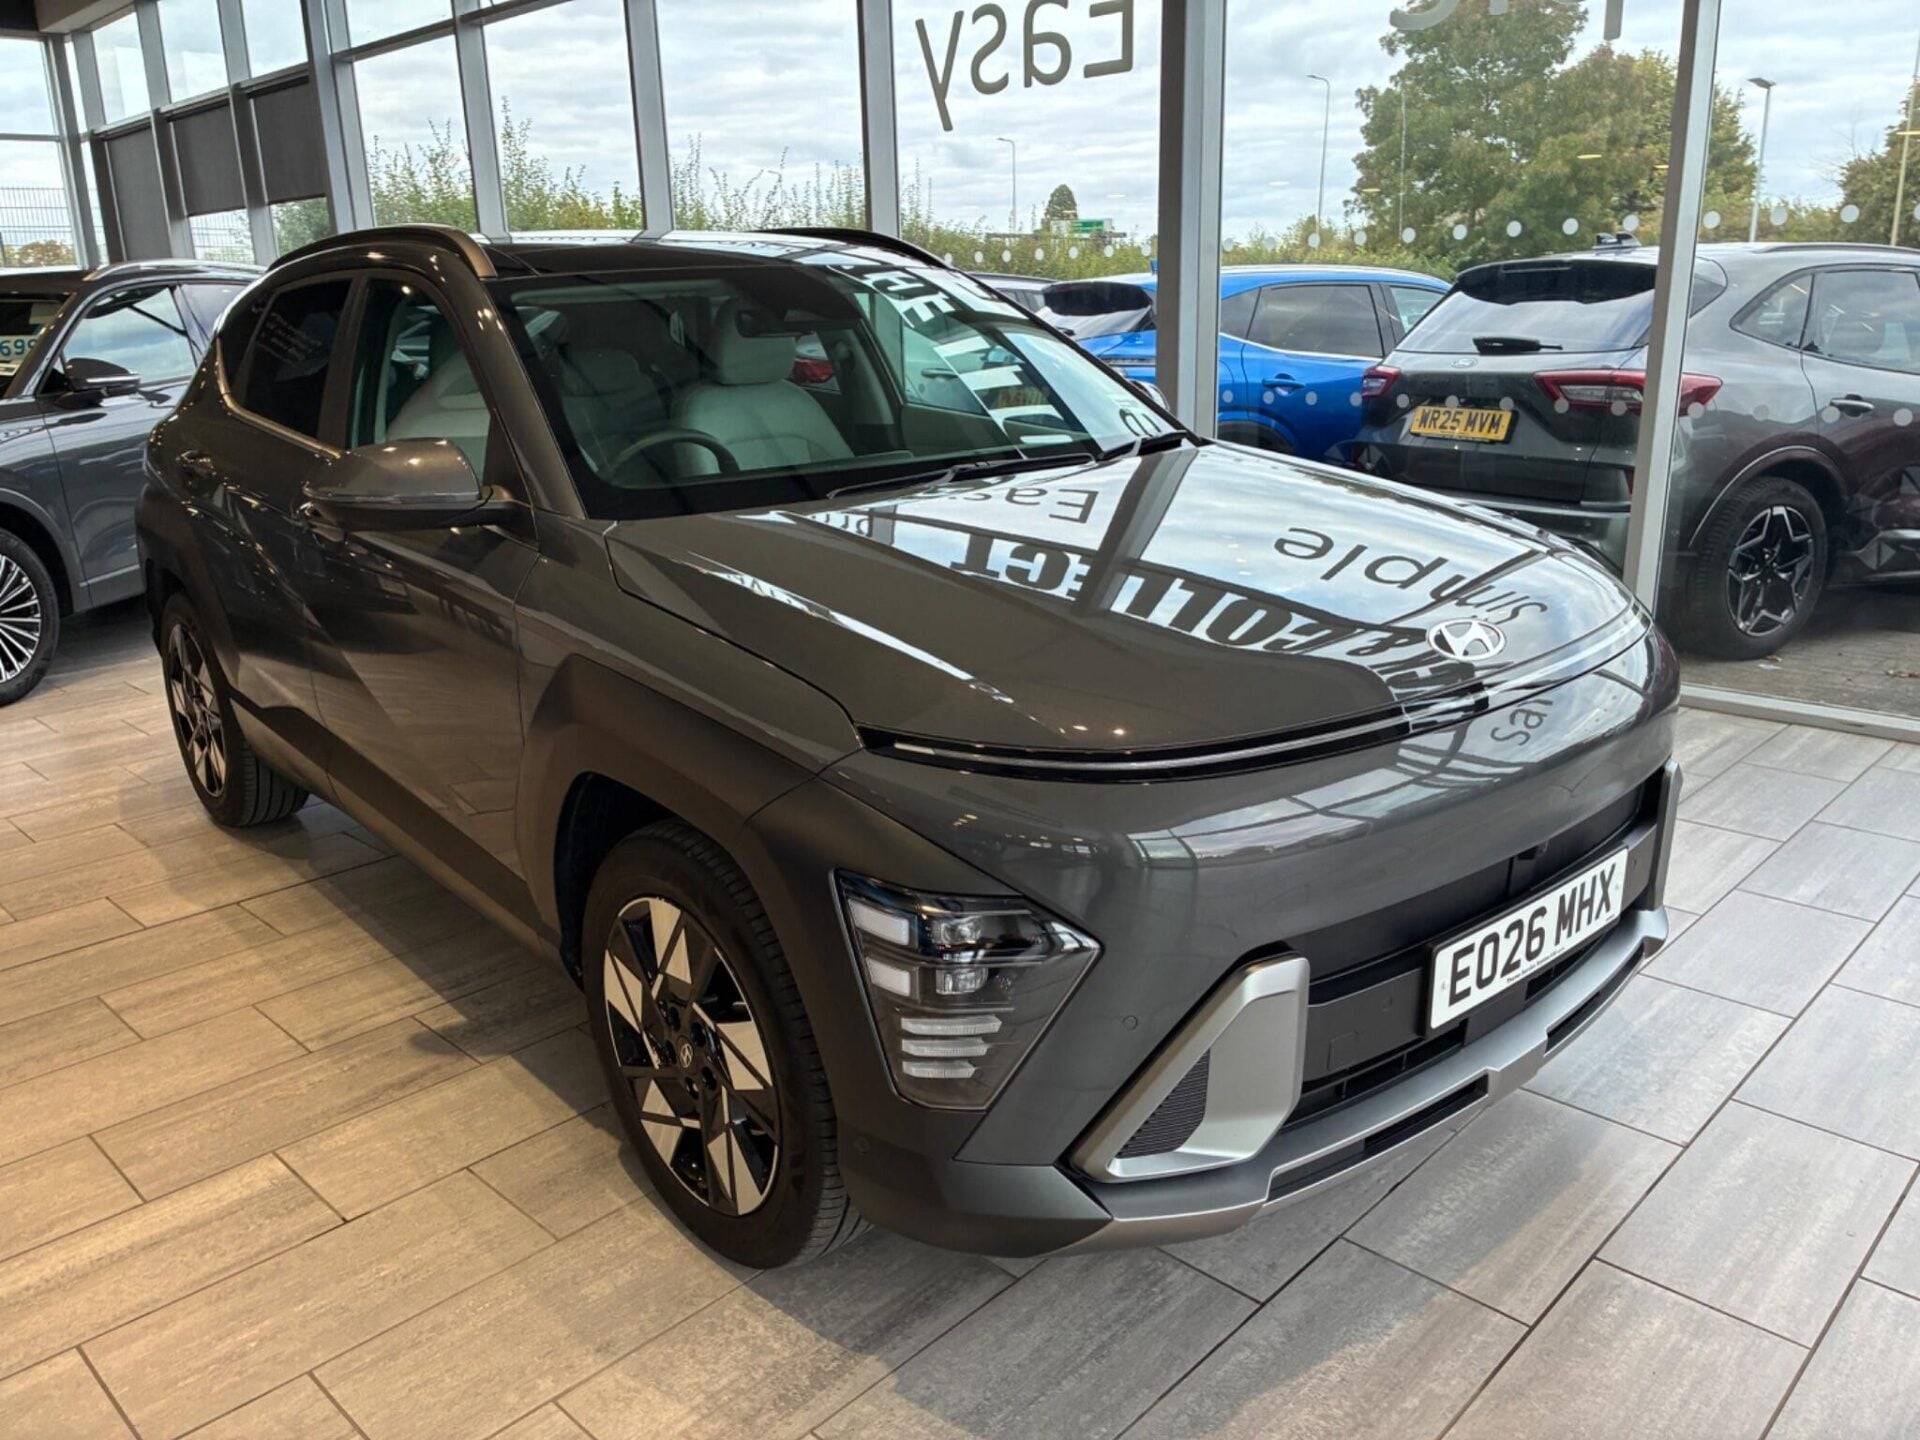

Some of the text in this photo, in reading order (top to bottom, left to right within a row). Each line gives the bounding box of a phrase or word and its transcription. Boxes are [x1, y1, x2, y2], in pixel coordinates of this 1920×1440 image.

[1419, 409, 1503, 434] WR25 MVM
[1555, 863, 1616, 946] MHX
